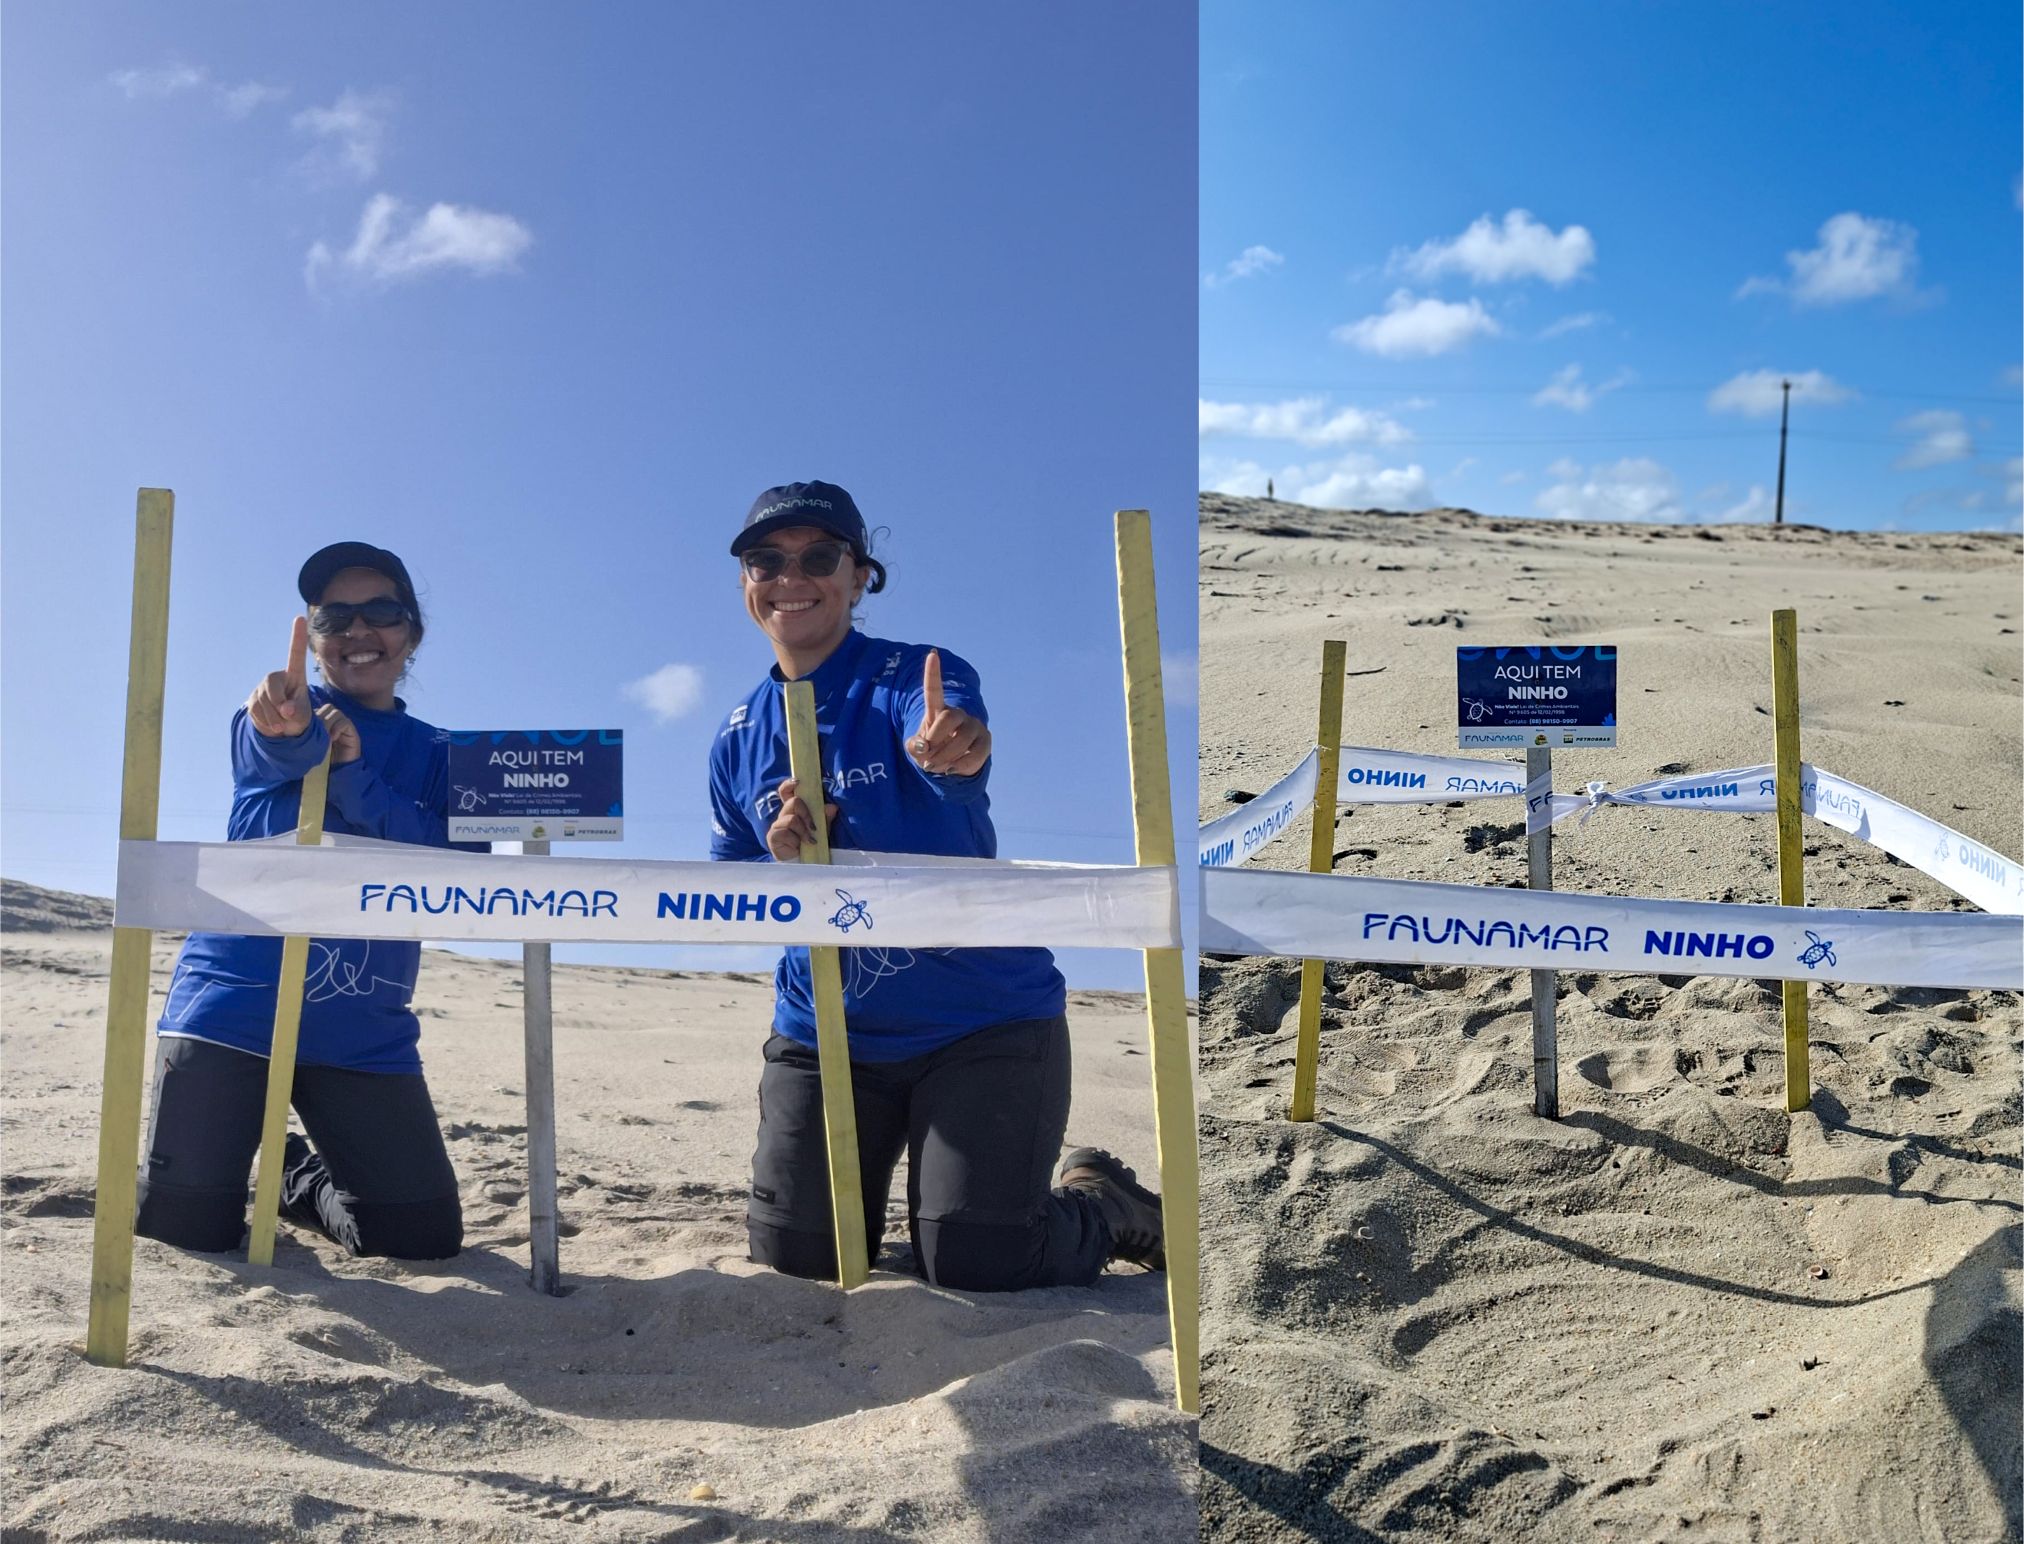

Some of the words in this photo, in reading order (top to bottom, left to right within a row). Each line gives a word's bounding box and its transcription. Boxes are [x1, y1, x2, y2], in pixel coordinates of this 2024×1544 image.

[1494, 665, 1539, 682] AQUI
[1542, 665, 1581, 679] TEM
[1508, 686, 1568, 700] NINHO
[488, 750, 538, 769] AQUI
[541, 750, 584, 766] TEM
[503, 773, 570, 788] NINHO
[456, 826, 520, 834] FAUNAMAR
[360, 883, 619, 918] FAUNAMAR
[657, 892, 802, 922] NINHO
[1363, 913, 1609, 952] FAUNAMAR
[1643, 929, 1775, 960] NINHO
